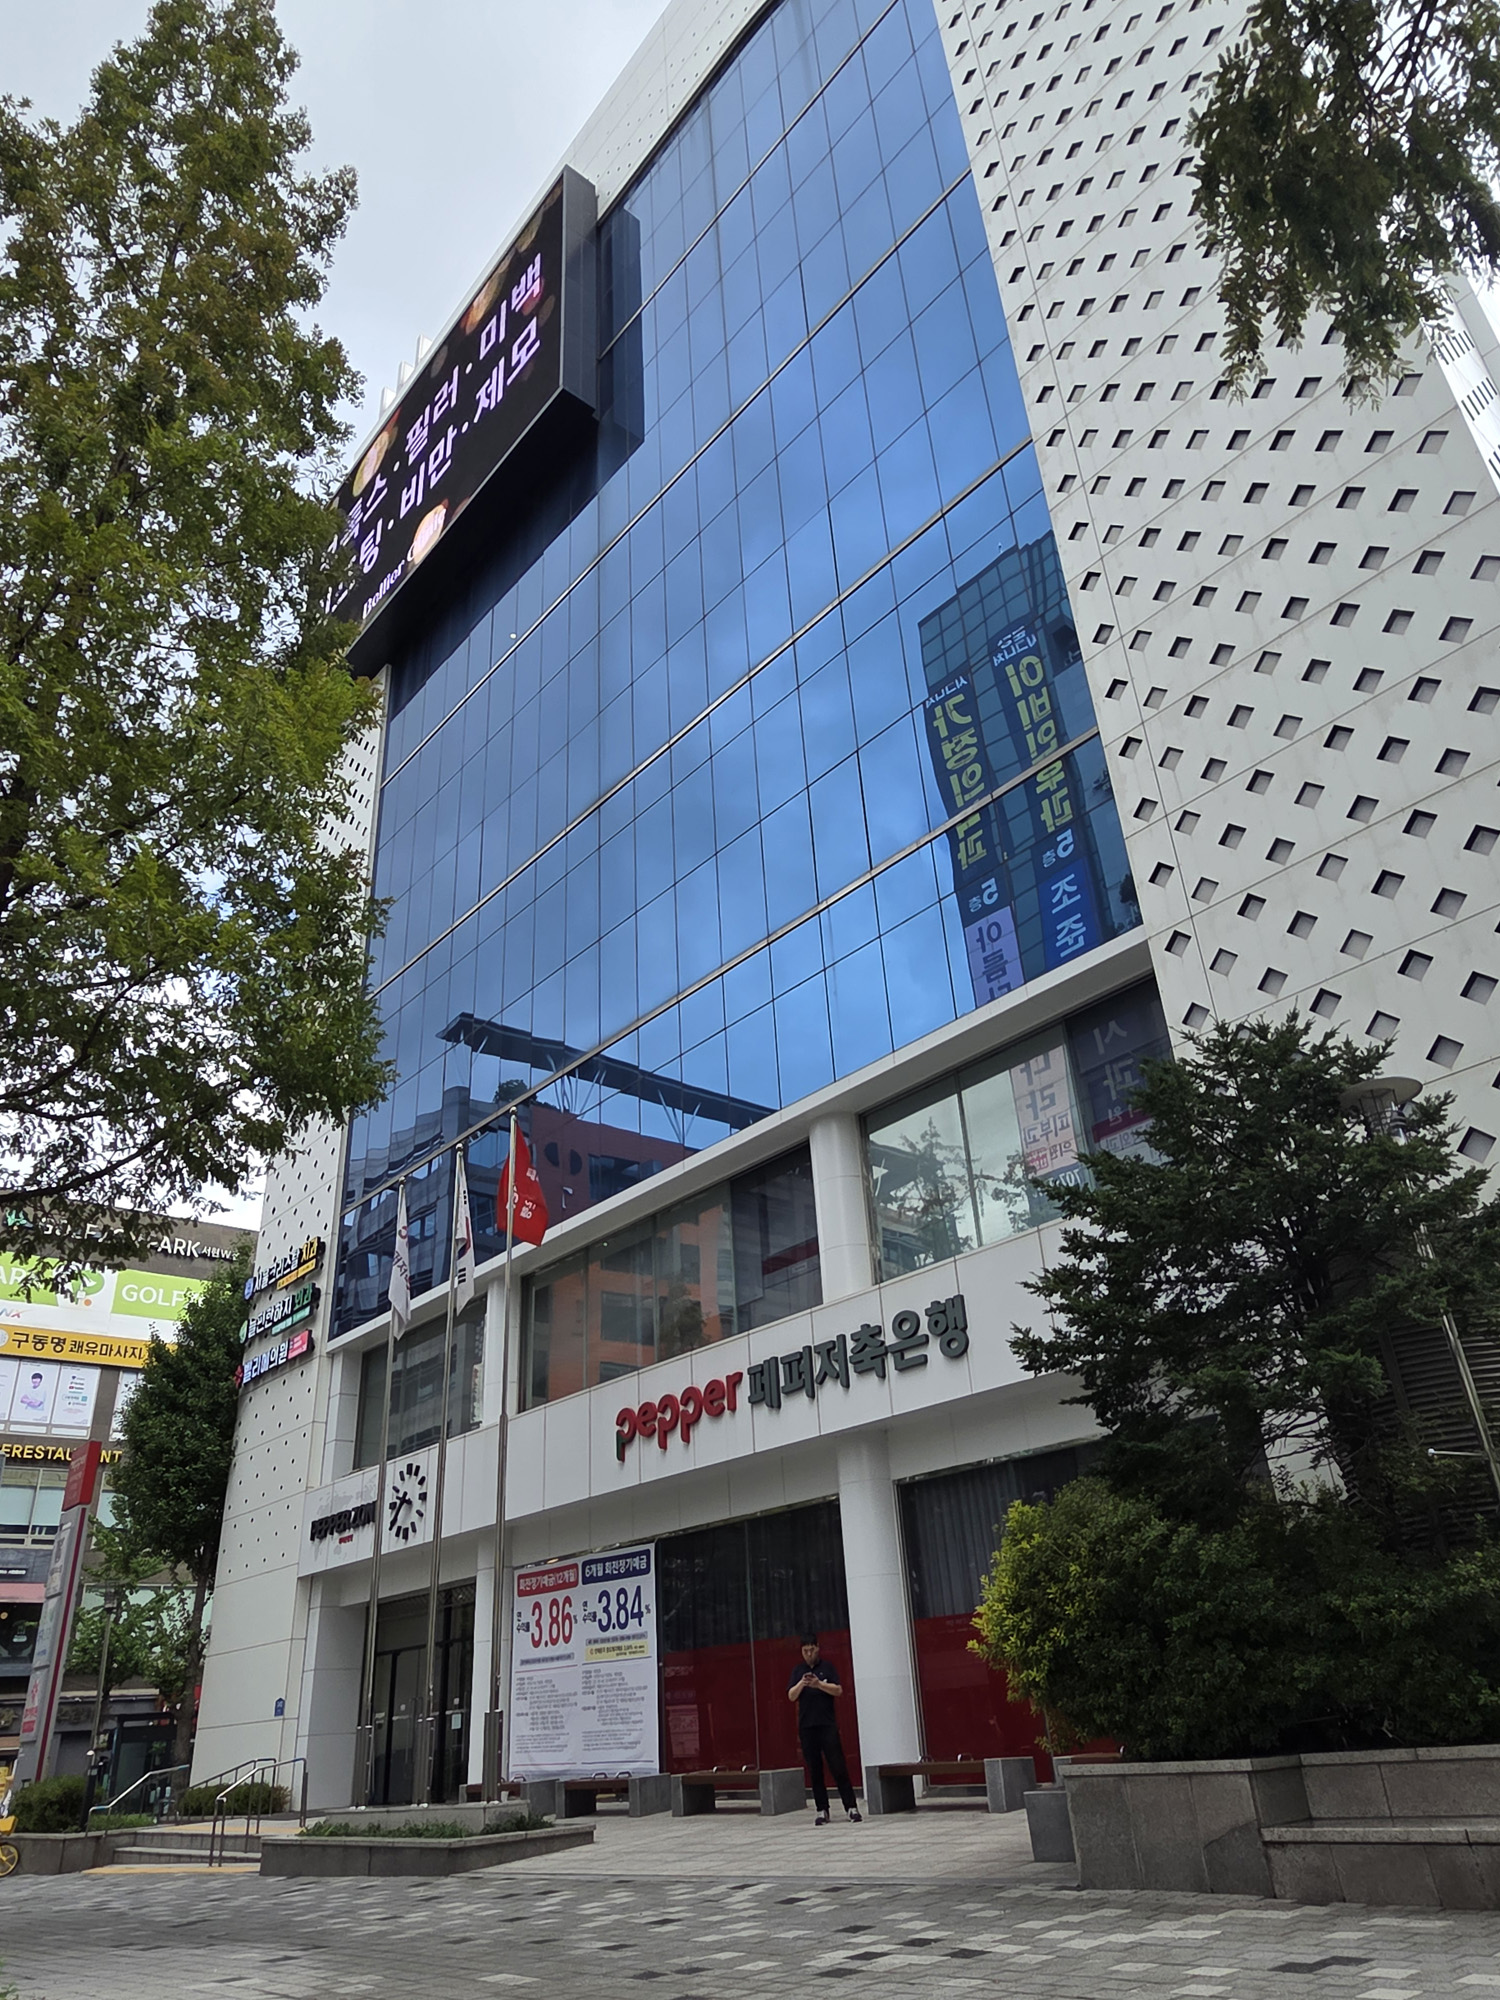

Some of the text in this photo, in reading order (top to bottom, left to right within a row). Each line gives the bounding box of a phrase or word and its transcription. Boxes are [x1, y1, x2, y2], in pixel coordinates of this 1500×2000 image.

[12, 1332, 143, 1360] 구동명 쾌유마사지
[616, 1294, 970, 1462] pepper 페퍼저축은행
